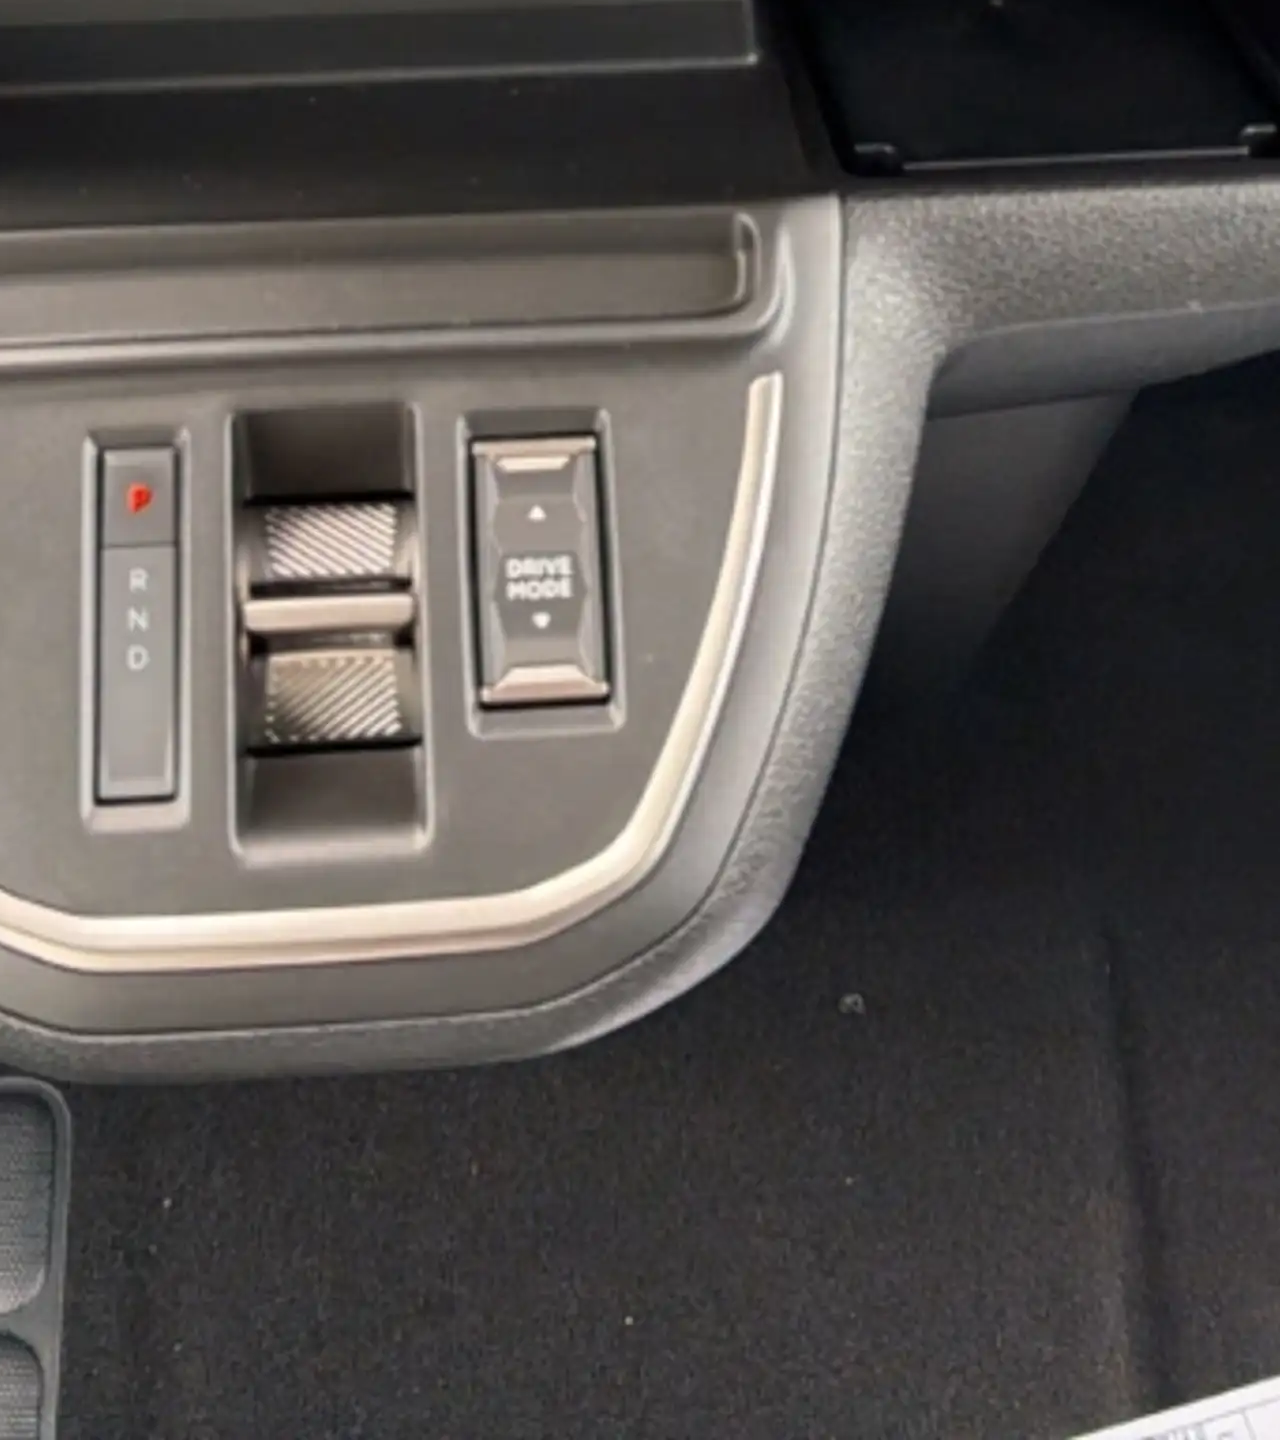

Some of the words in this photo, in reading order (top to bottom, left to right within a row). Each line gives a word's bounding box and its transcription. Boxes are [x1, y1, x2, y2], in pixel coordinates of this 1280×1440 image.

[125, 484, 154, 513] P
[505, 555, 574, 579] DRIVE
[129, 568, 149, 592] R
[506, 577, 574, 601] MODE
[128, 608, 149, 632] N
[126, 644, 150, 670] D
